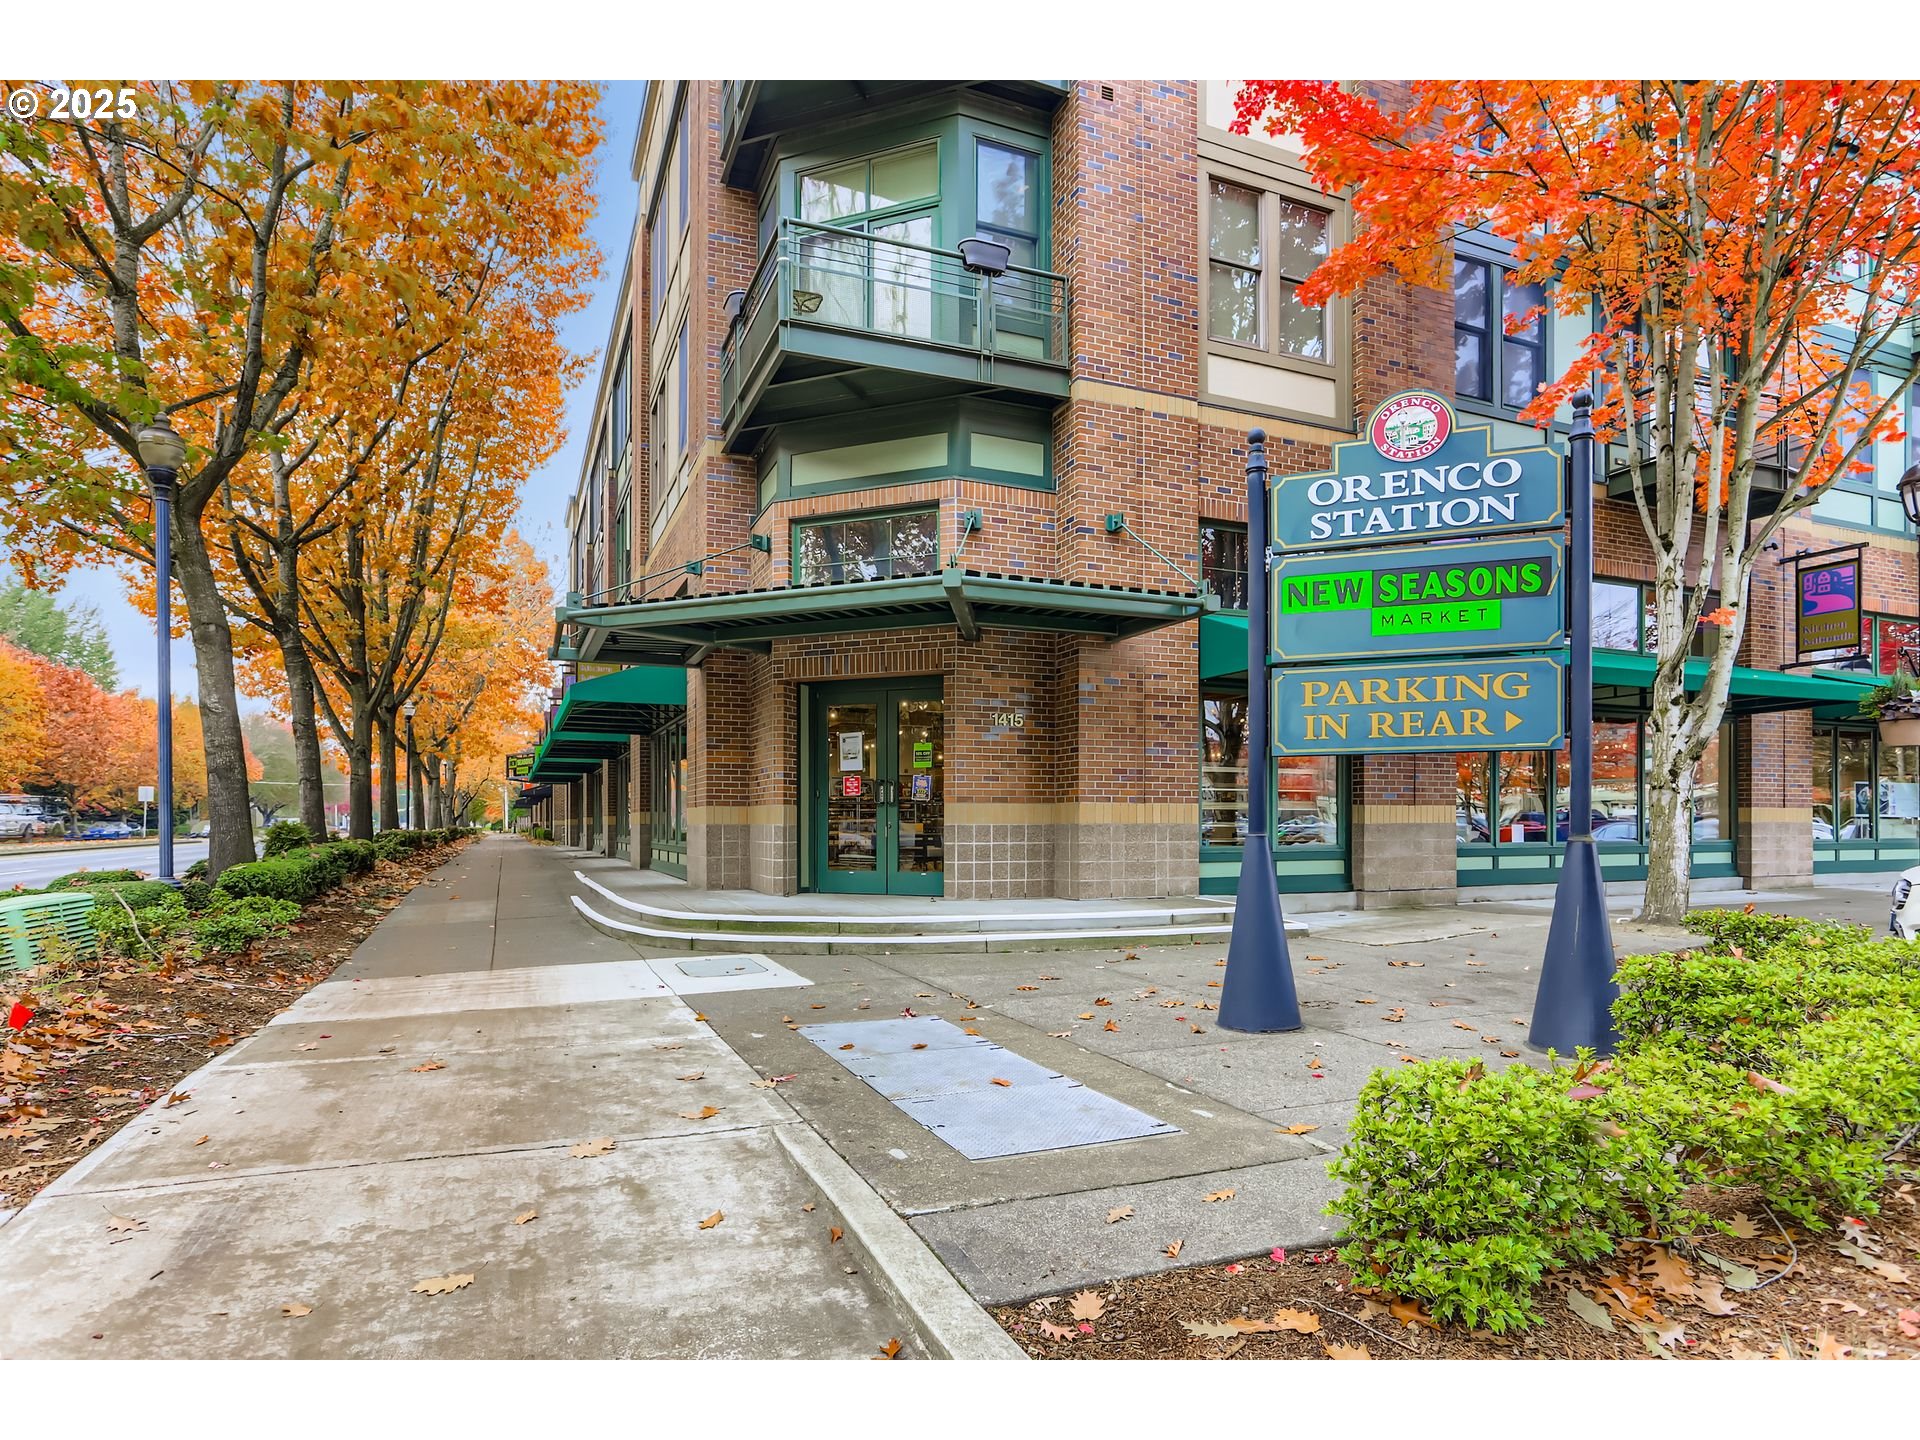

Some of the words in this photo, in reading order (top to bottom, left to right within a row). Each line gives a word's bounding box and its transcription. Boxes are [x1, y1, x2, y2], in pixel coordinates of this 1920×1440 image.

[1380, 398, 1441, 420] ORENCO
[1380, 437, 1441, 458] STATION
[1307, 458, 1522, 506] ORENCO
[1310, 492, 1520, 540] STATION
[1287, 577, 1365, 609] NEW
[1378, 562, 1542, 603] SEASONS
[1381, 607, 1489, 627] MARKET
[1301, 672, 1531, 708] PARKING
[991, 713, 1024, 727] 1415
[1303, 713, 1350, 741] IN
[1368, 708, 1495, 740] REAR
